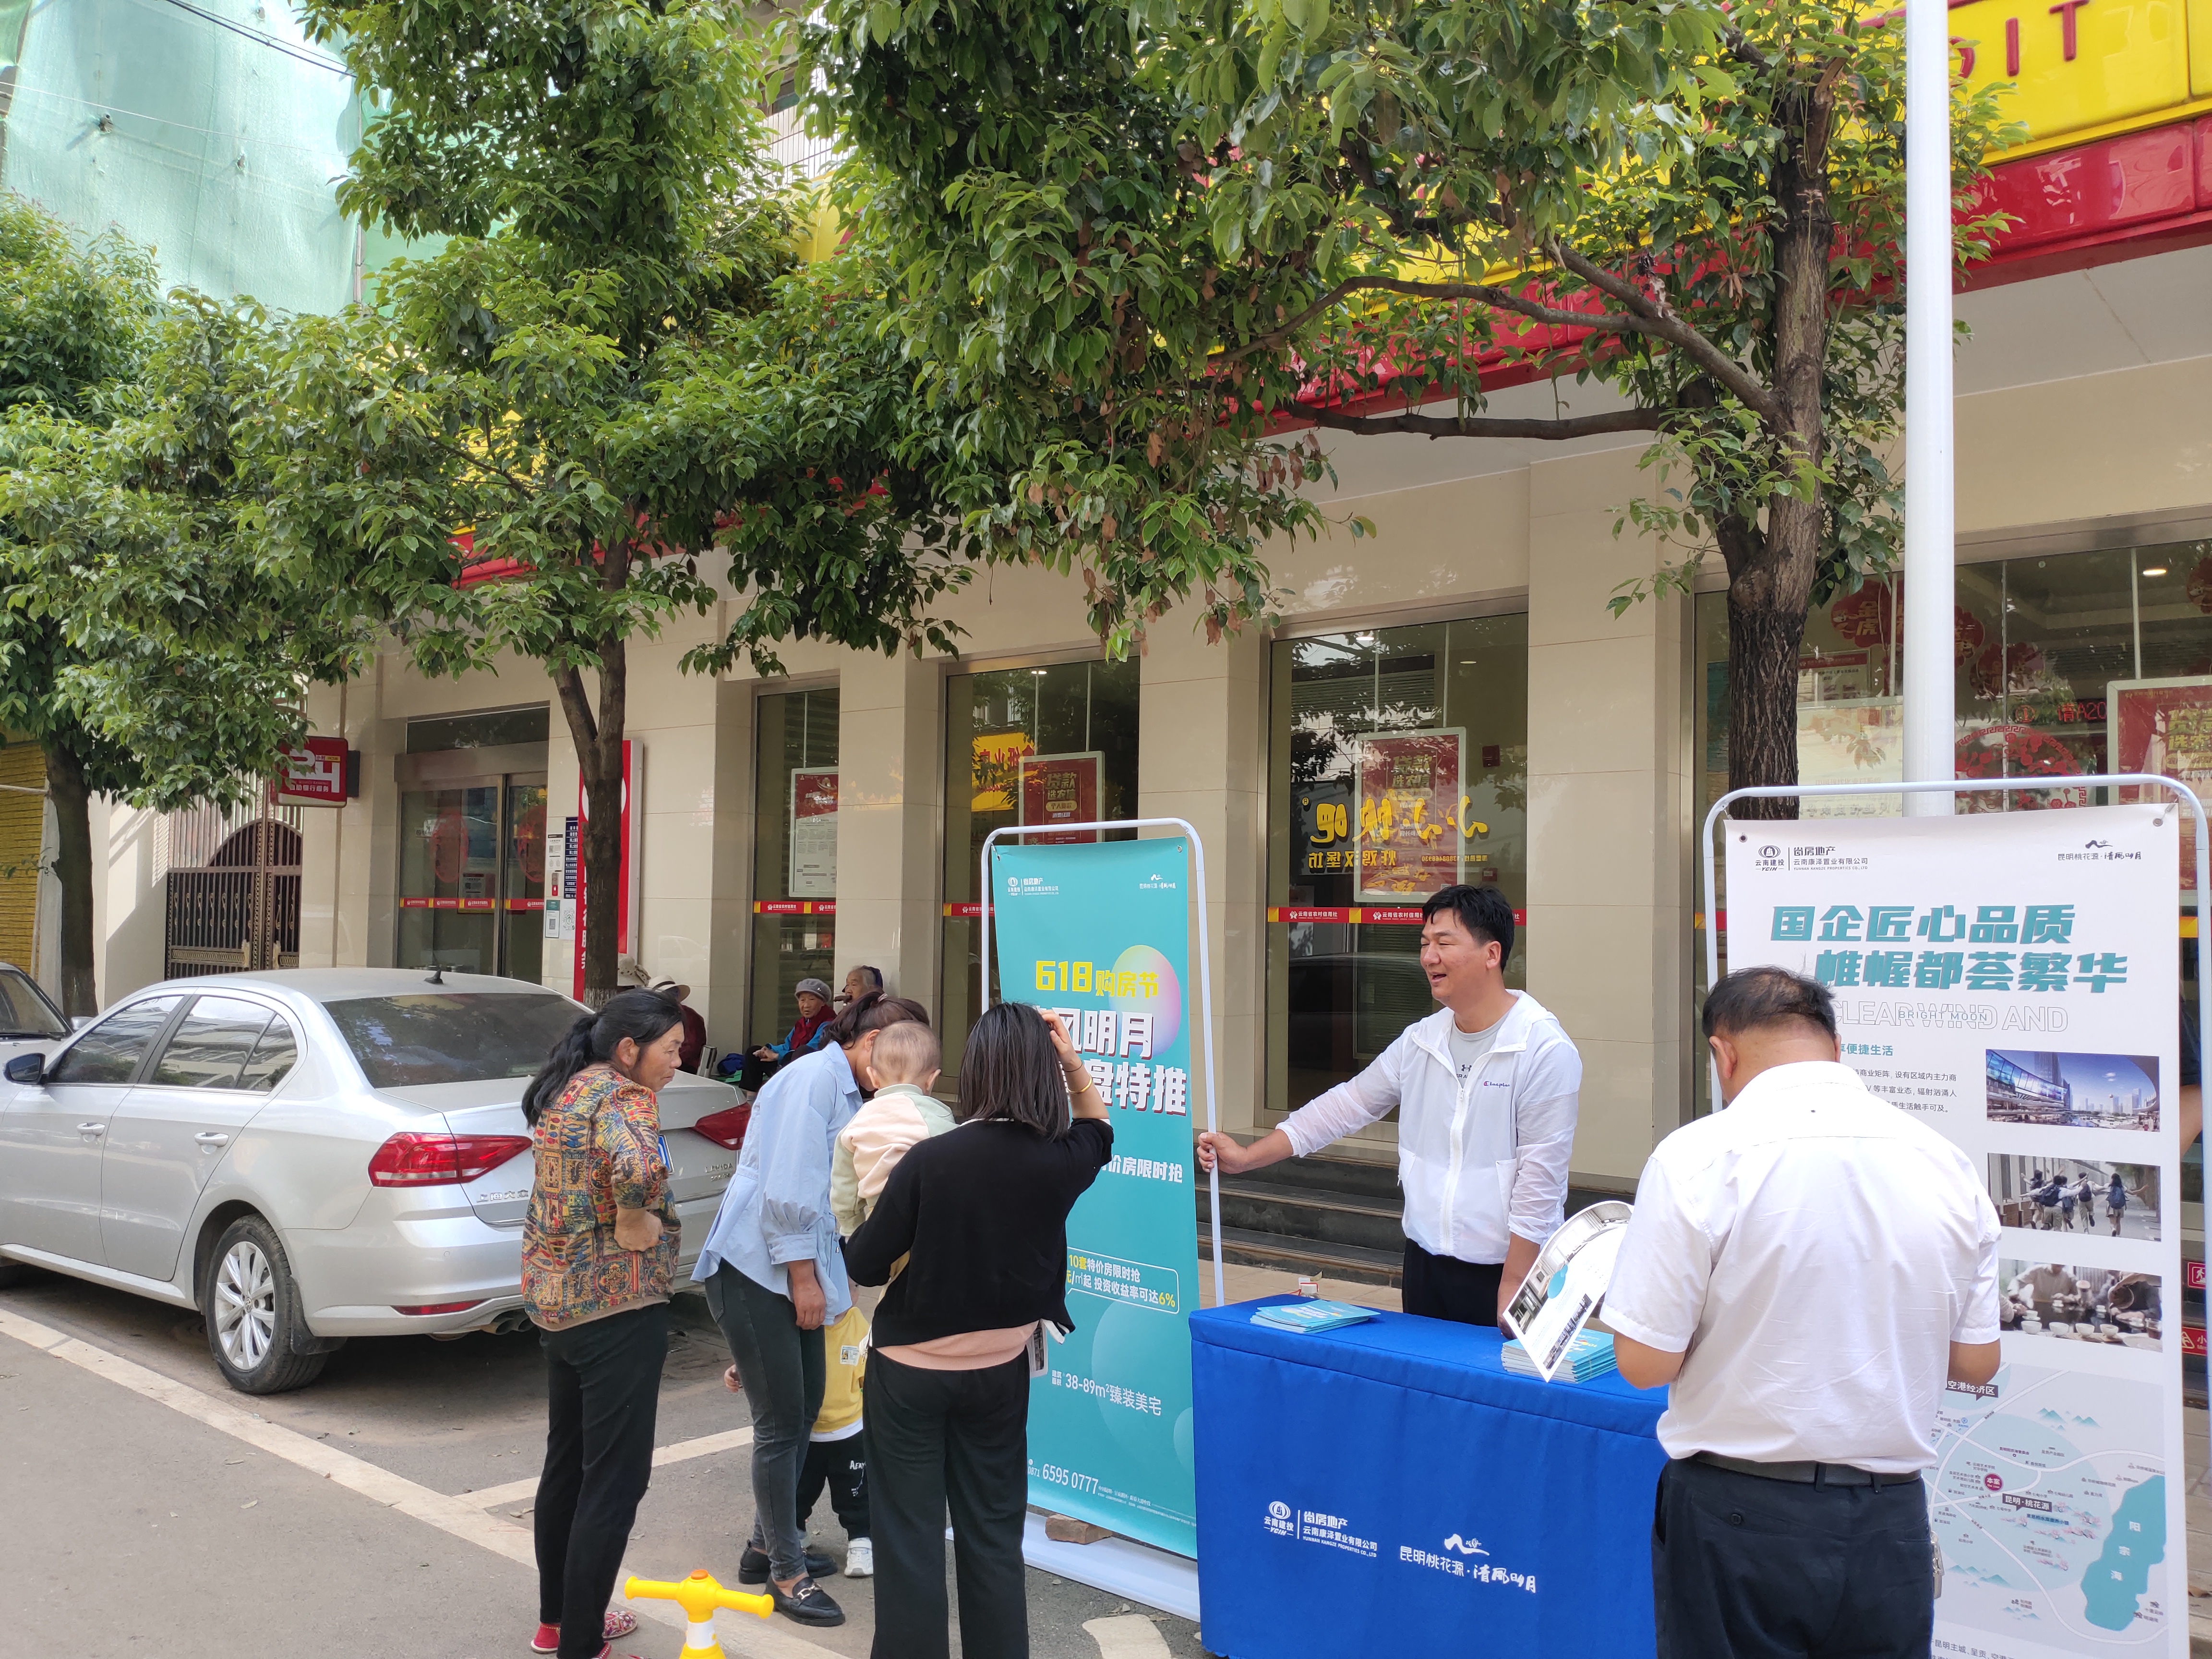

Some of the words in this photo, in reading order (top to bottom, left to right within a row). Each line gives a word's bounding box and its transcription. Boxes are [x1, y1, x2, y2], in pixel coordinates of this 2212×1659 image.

[1771, 904, 2075, 944] 国企匠心品质
[1035, 960, 1158, 998] 618购房节
[1815, 950, 2128, 994] 帷幄都荟繁华
[1899, 1010, 1943, 1021] BRIGHT
[1950, 1011, 1987, 1021] MOON
[2002, 1006, 2068, 1032] AND
[1036, 1005, 1154, 1058] 风明月
[1058, 1058, 1187, 1116] 盘特推
[1886, 1101, 1948, 1113] 质生活触手可及。
[705, 1163, 733, 1173] LAVIDA
[1102, 1154, 1183, 1183] 价房限时抢
[476, 1190, 529, 1202] 上海大众
[1069, 1254, 1141, 1283] 10套特价房限时抢
[1094, 1276, 1176, 1307] 投资收益率可达6%
[1948, 1381, 1995, 1395] 空港经济区
[1028, 1467, 1040, 1477] 0871
[1043, 1464, 1069, 1486] 6595
[1071, 1472, 1099, 1494] 0777
[1264, 1516, 1294, 1531] 云南建投
[1302, 1535, 1320, 1544] YUNNAN
[1321, 1539, 1336, 1547] KANGZE
[1338, 1541, 1359, 1554] PROPERTIES
[1303, 1526, 1377, 1551] 云南康泽置业有限公司
